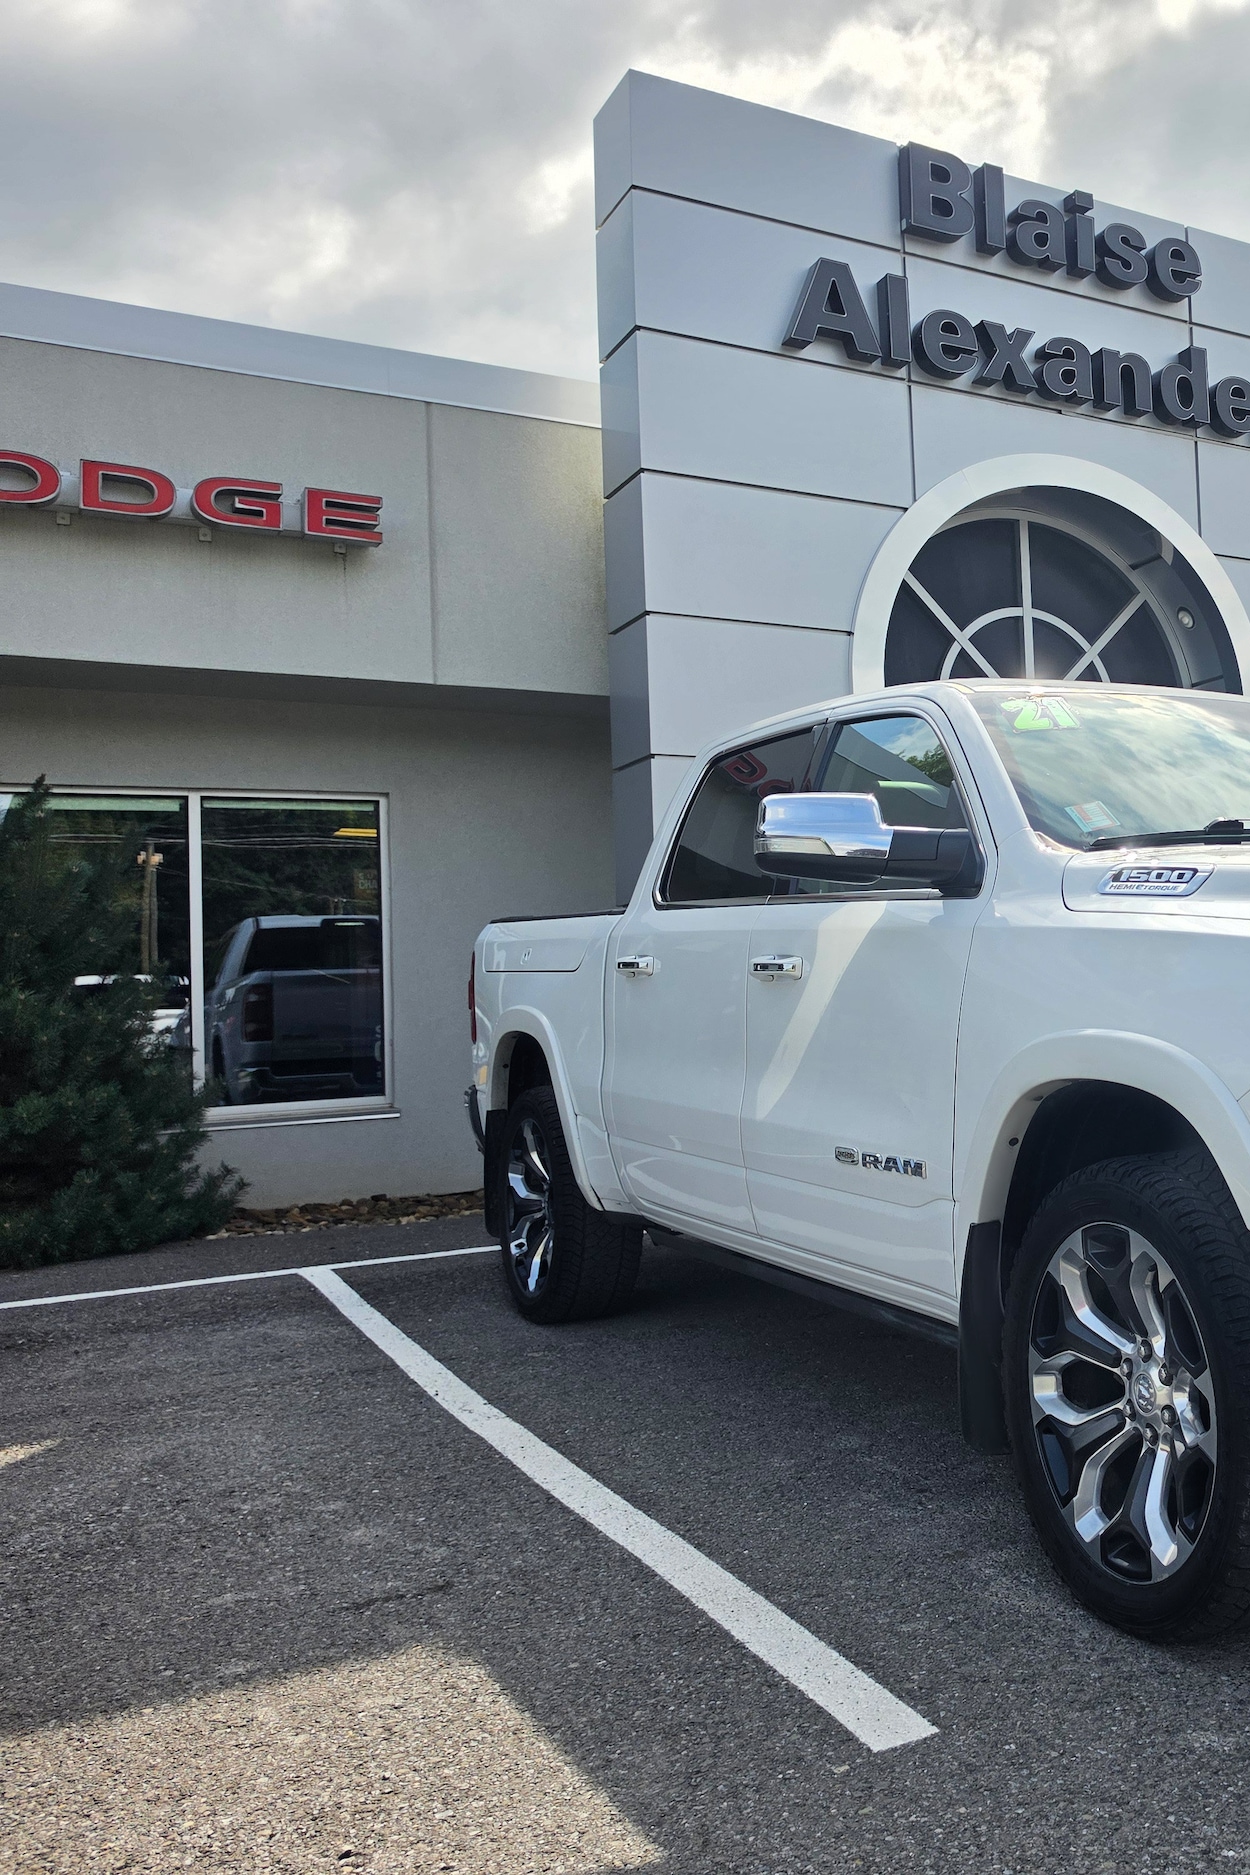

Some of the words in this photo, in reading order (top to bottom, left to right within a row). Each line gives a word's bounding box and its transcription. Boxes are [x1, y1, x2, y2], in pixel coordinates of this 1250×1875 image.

[900, 141, 1203, 303] Blaise
[1000, 697, 1081, 731] 21
[1109, 882, 1136, 891] HEMI
[1119, 868, 1196, 883] 1500
[861, 1151, 928, 1180] RAM
